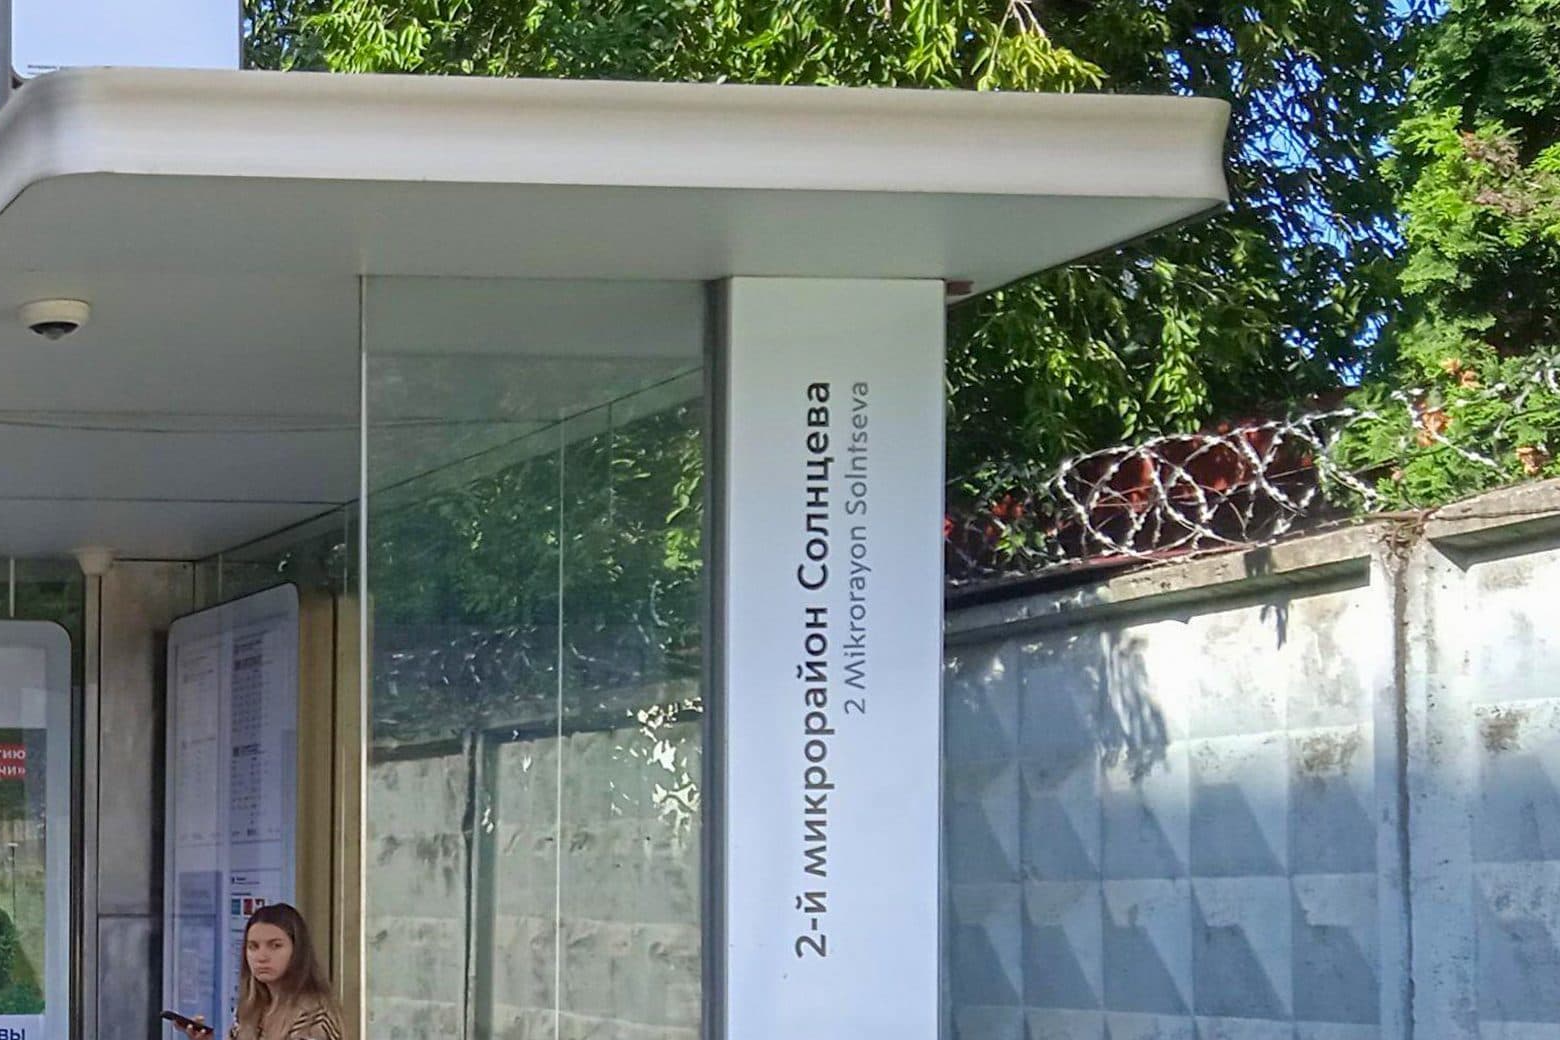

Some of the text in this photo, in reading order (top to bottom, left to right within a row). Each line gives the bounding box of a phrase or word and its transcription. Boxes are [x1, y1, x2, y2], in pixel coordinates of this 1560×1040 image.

[795, 382, 835, 958] 2-й микрорайон Солнцева
[843, 381, 872, 714] 2 Mikrorayon Solntseva
